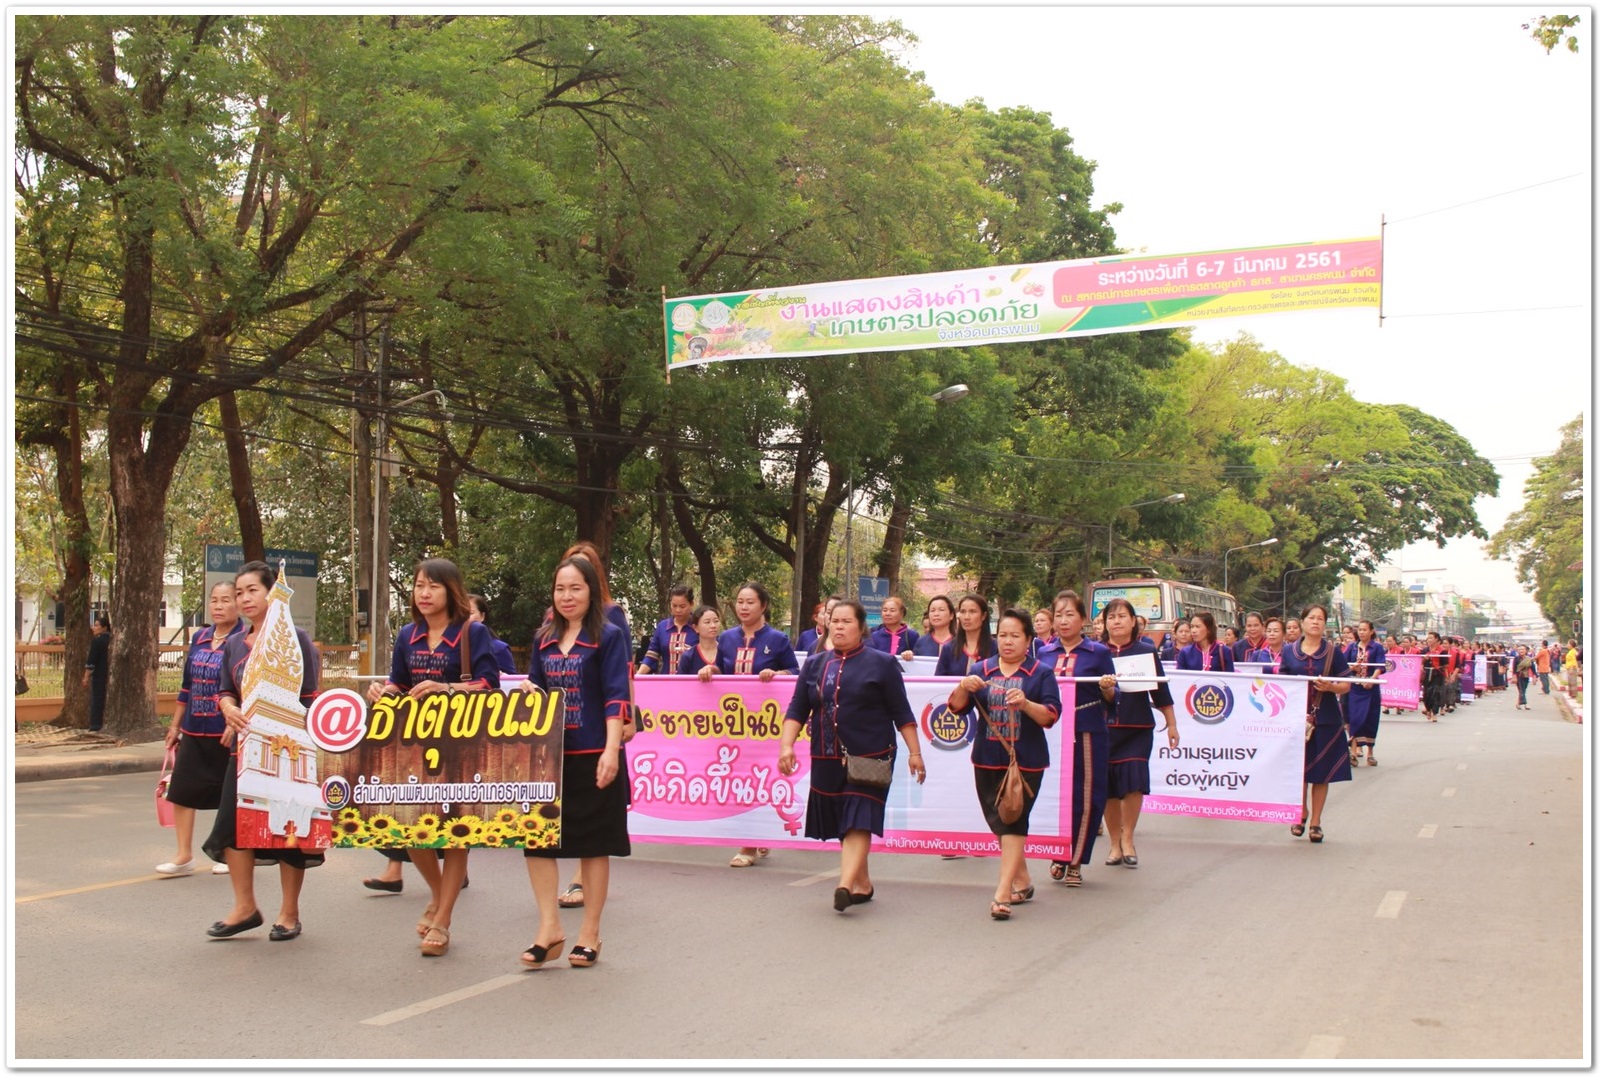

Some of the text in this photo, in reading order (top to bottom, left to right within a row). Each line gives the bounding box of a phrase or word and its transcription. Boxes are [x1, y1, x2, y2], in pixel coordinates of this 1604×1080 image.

[1098, 250, 1342, 286] ระหว่างวันที่ 6-7 มีนาคม 2561
[780, 282, 982, 322] งานแสดงสินค้า
[830, 297, 1039, 337] เกษตรปลอดภัย
[937, 321, 1041, 342] จังหวัดนครพนม
[1096, 588, 1127, 597] KUMON
[1158, 743, 1258, 767] ความรุนแรง
[354, 775, 556, 812] สำนักงานพัฒนาชุมชนอำเภอธาตุพนม
[1165, 768, 1250, 791] ต่อผู้หญิง
